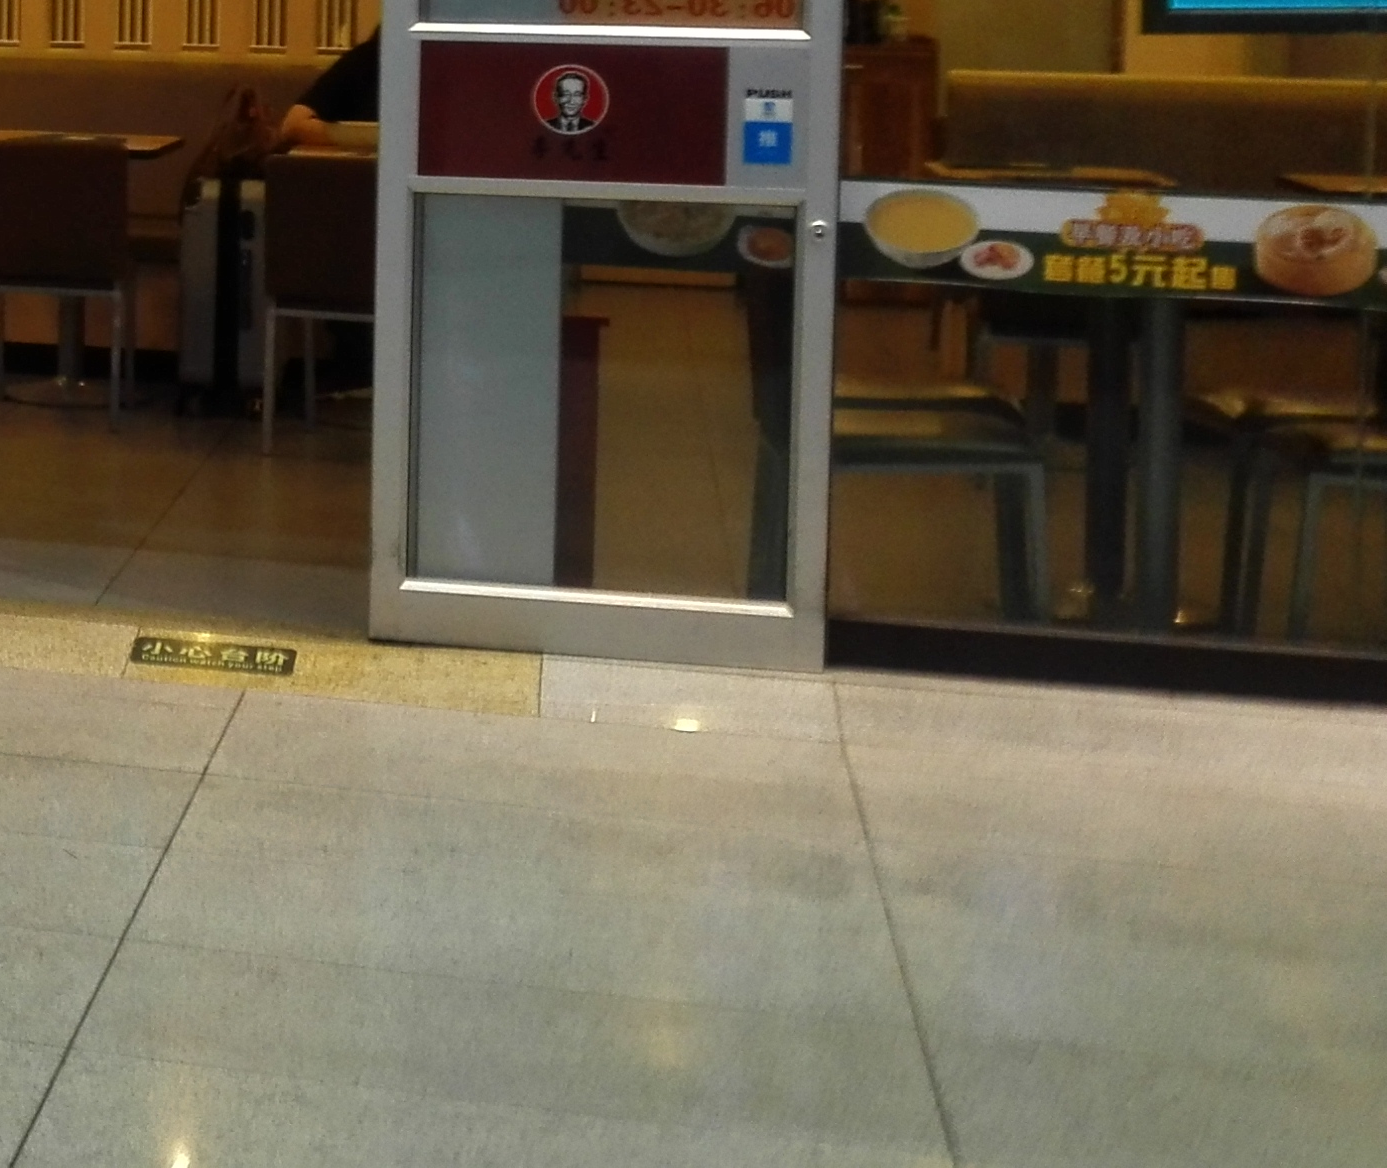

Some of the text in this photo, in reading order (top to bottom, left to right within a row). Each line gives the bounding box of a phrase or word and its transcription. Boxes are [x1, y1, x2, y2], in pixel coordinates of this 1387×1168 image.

[746, 89, 793, 98] PUSH
[141, 641, 291, 666] 小心台阶
